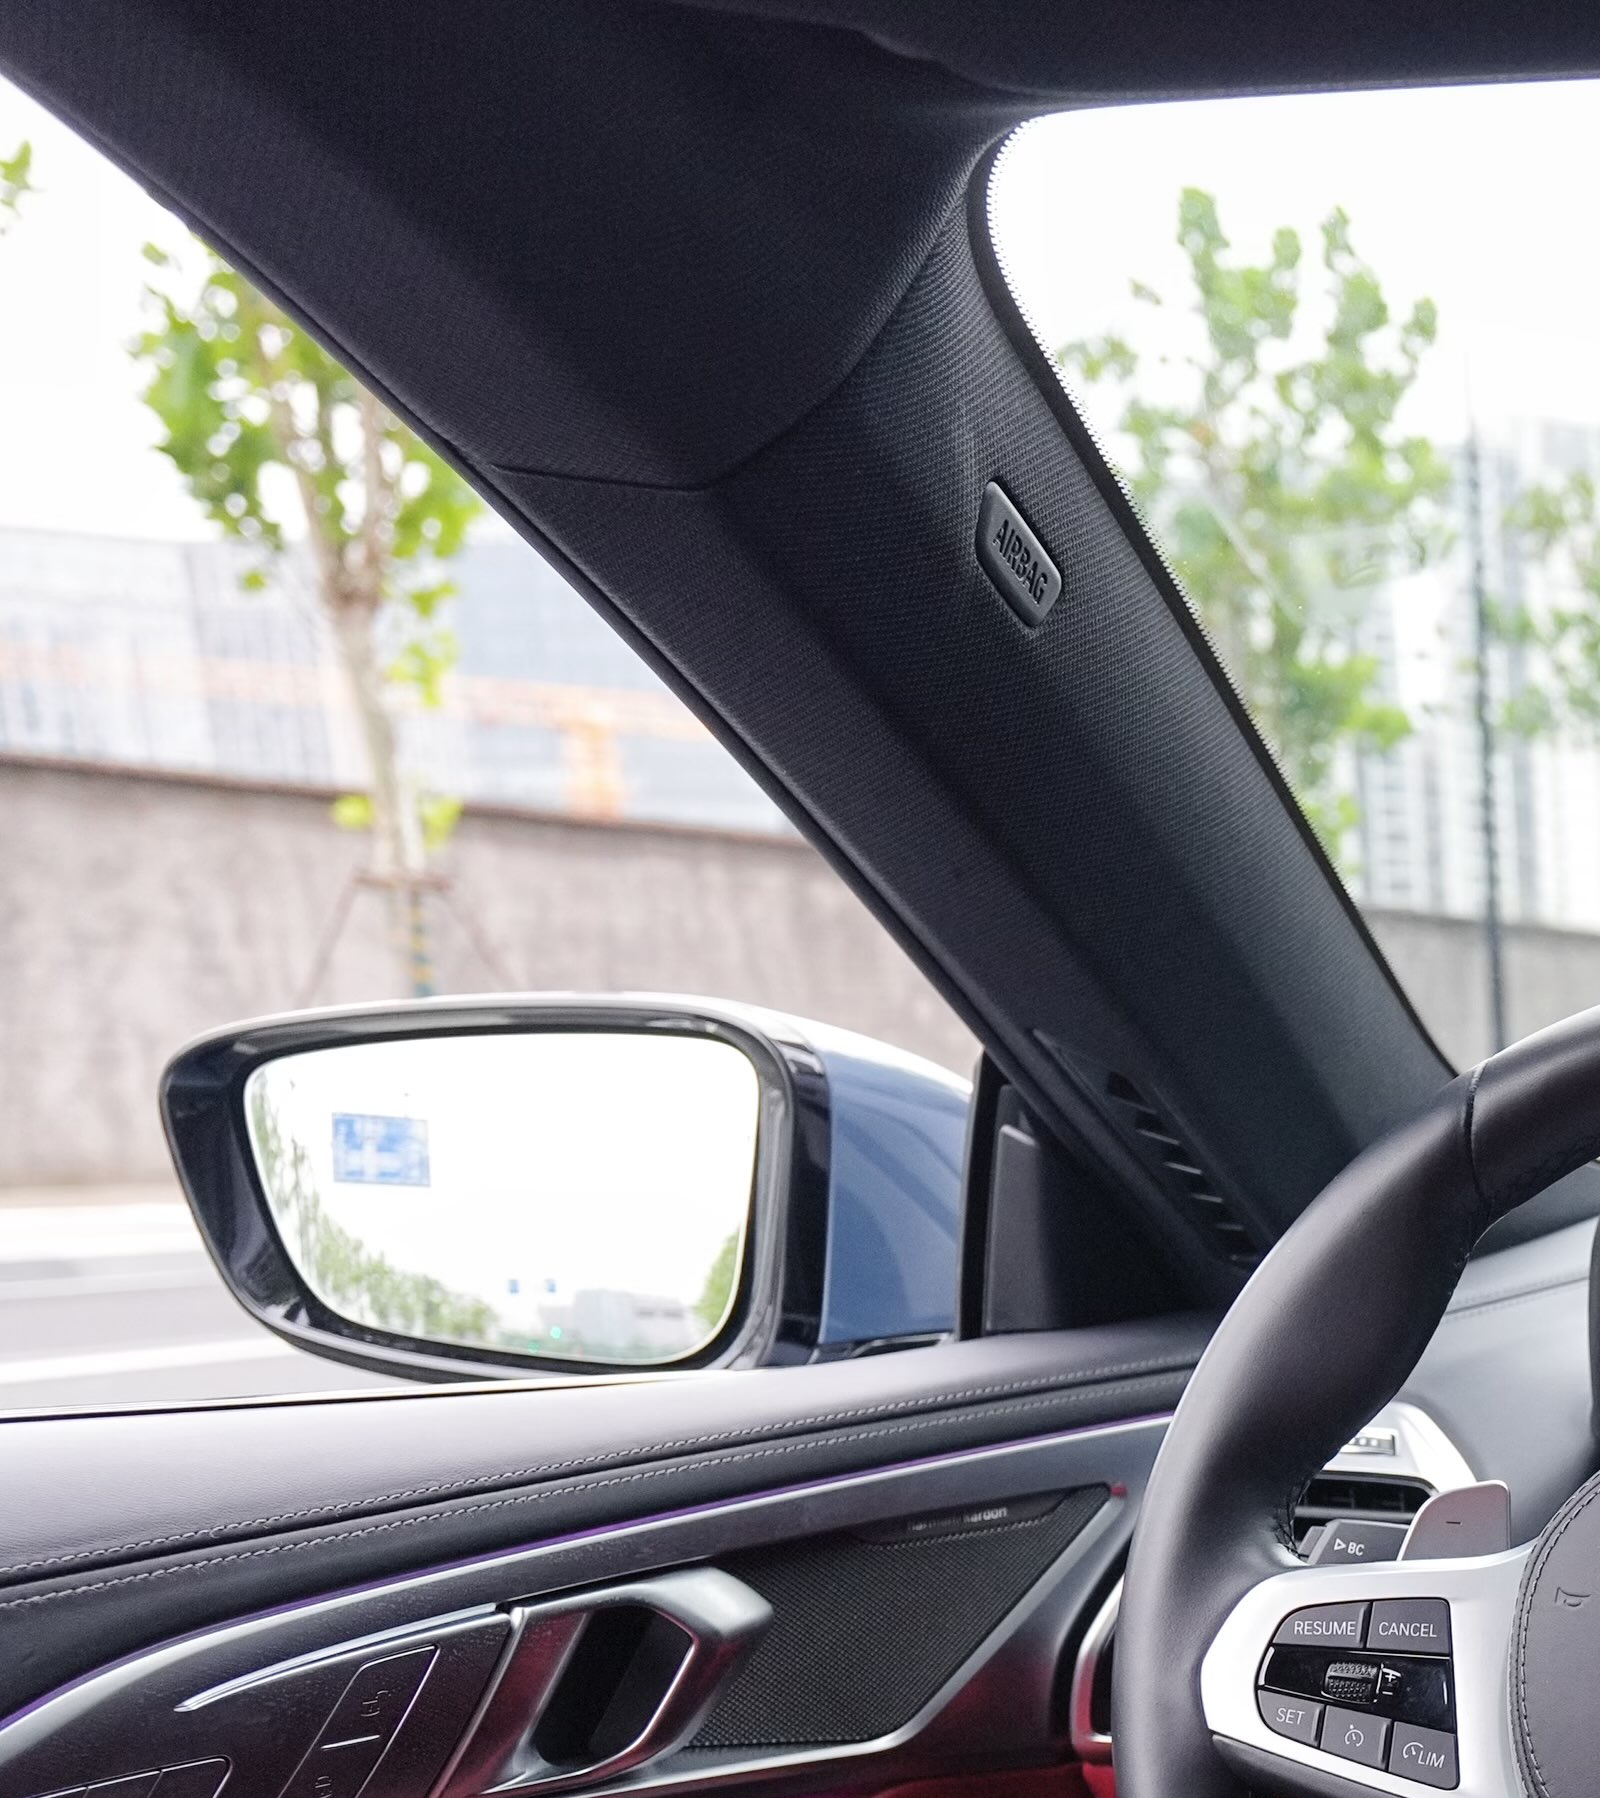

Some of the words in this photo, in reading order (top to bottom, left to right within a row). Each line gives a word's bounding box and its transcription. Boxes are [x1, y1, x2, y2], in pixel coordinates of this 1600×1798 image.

[992, 519, 1048, 606] AIRBAG
[1347, 1542, 1365, 1556] BC
[1294, 1620, 1356, 1636] RESUME
[1379, 1622, 1437, 1638] CANCEL
[1276, 1707, 1305, 1725] SET
[1417, 1752, 1445, 1769] LIM
